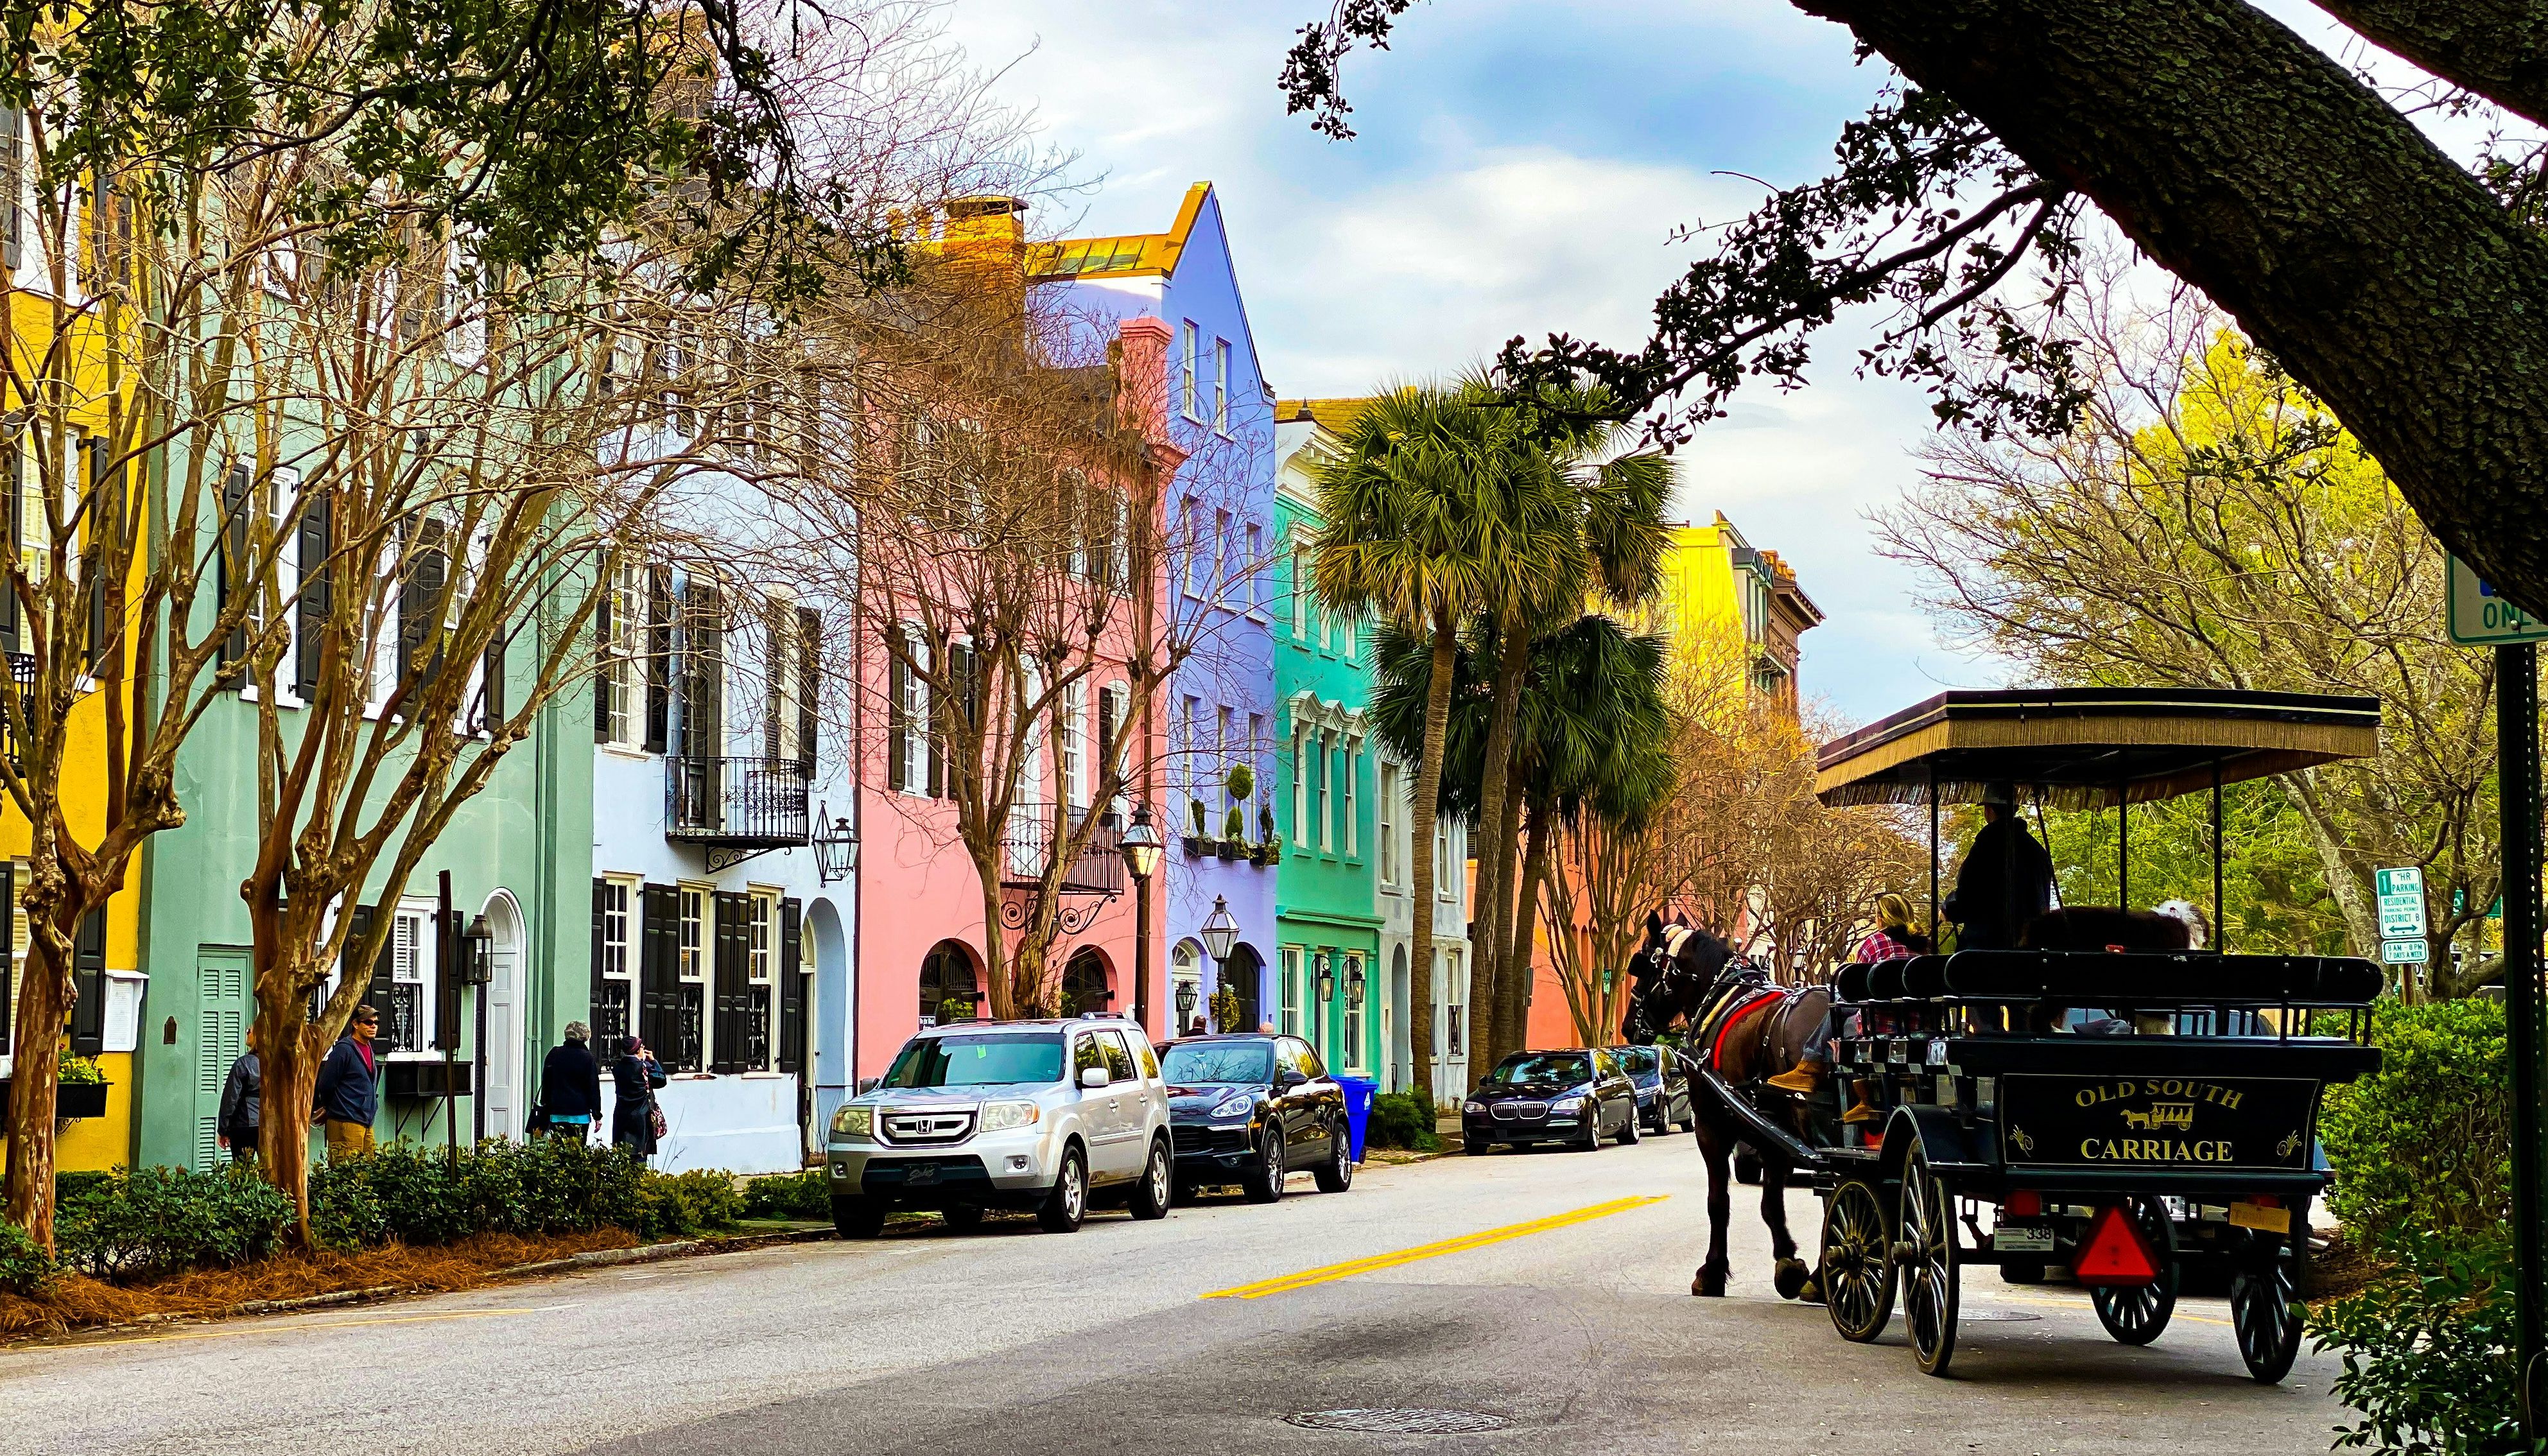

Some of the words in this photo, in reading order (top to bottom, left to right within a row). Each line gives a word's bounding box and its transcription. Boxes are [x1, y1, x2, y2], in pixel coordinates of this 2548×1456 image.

[2483, 602, 2543, 629] ONL
[2382, 874, 2388, 892] 1
[2400, 872, 2411, 881] HR
[2392, 883, 2419, 892] PARKING
[2384, 896, 2418, 906] RESIDENTIAL
[2384, 914, 2411, 924] DISTRICT
[2415, 913, 2420, 922] B
[2076, 1082, 2136, 1107] OLD
[2145, 1079, 2244, 1110] SOUTH
[2081, 1138, 2233, 1162] CARRIAGE
[2025, 1227, 2052, 1240] 338
